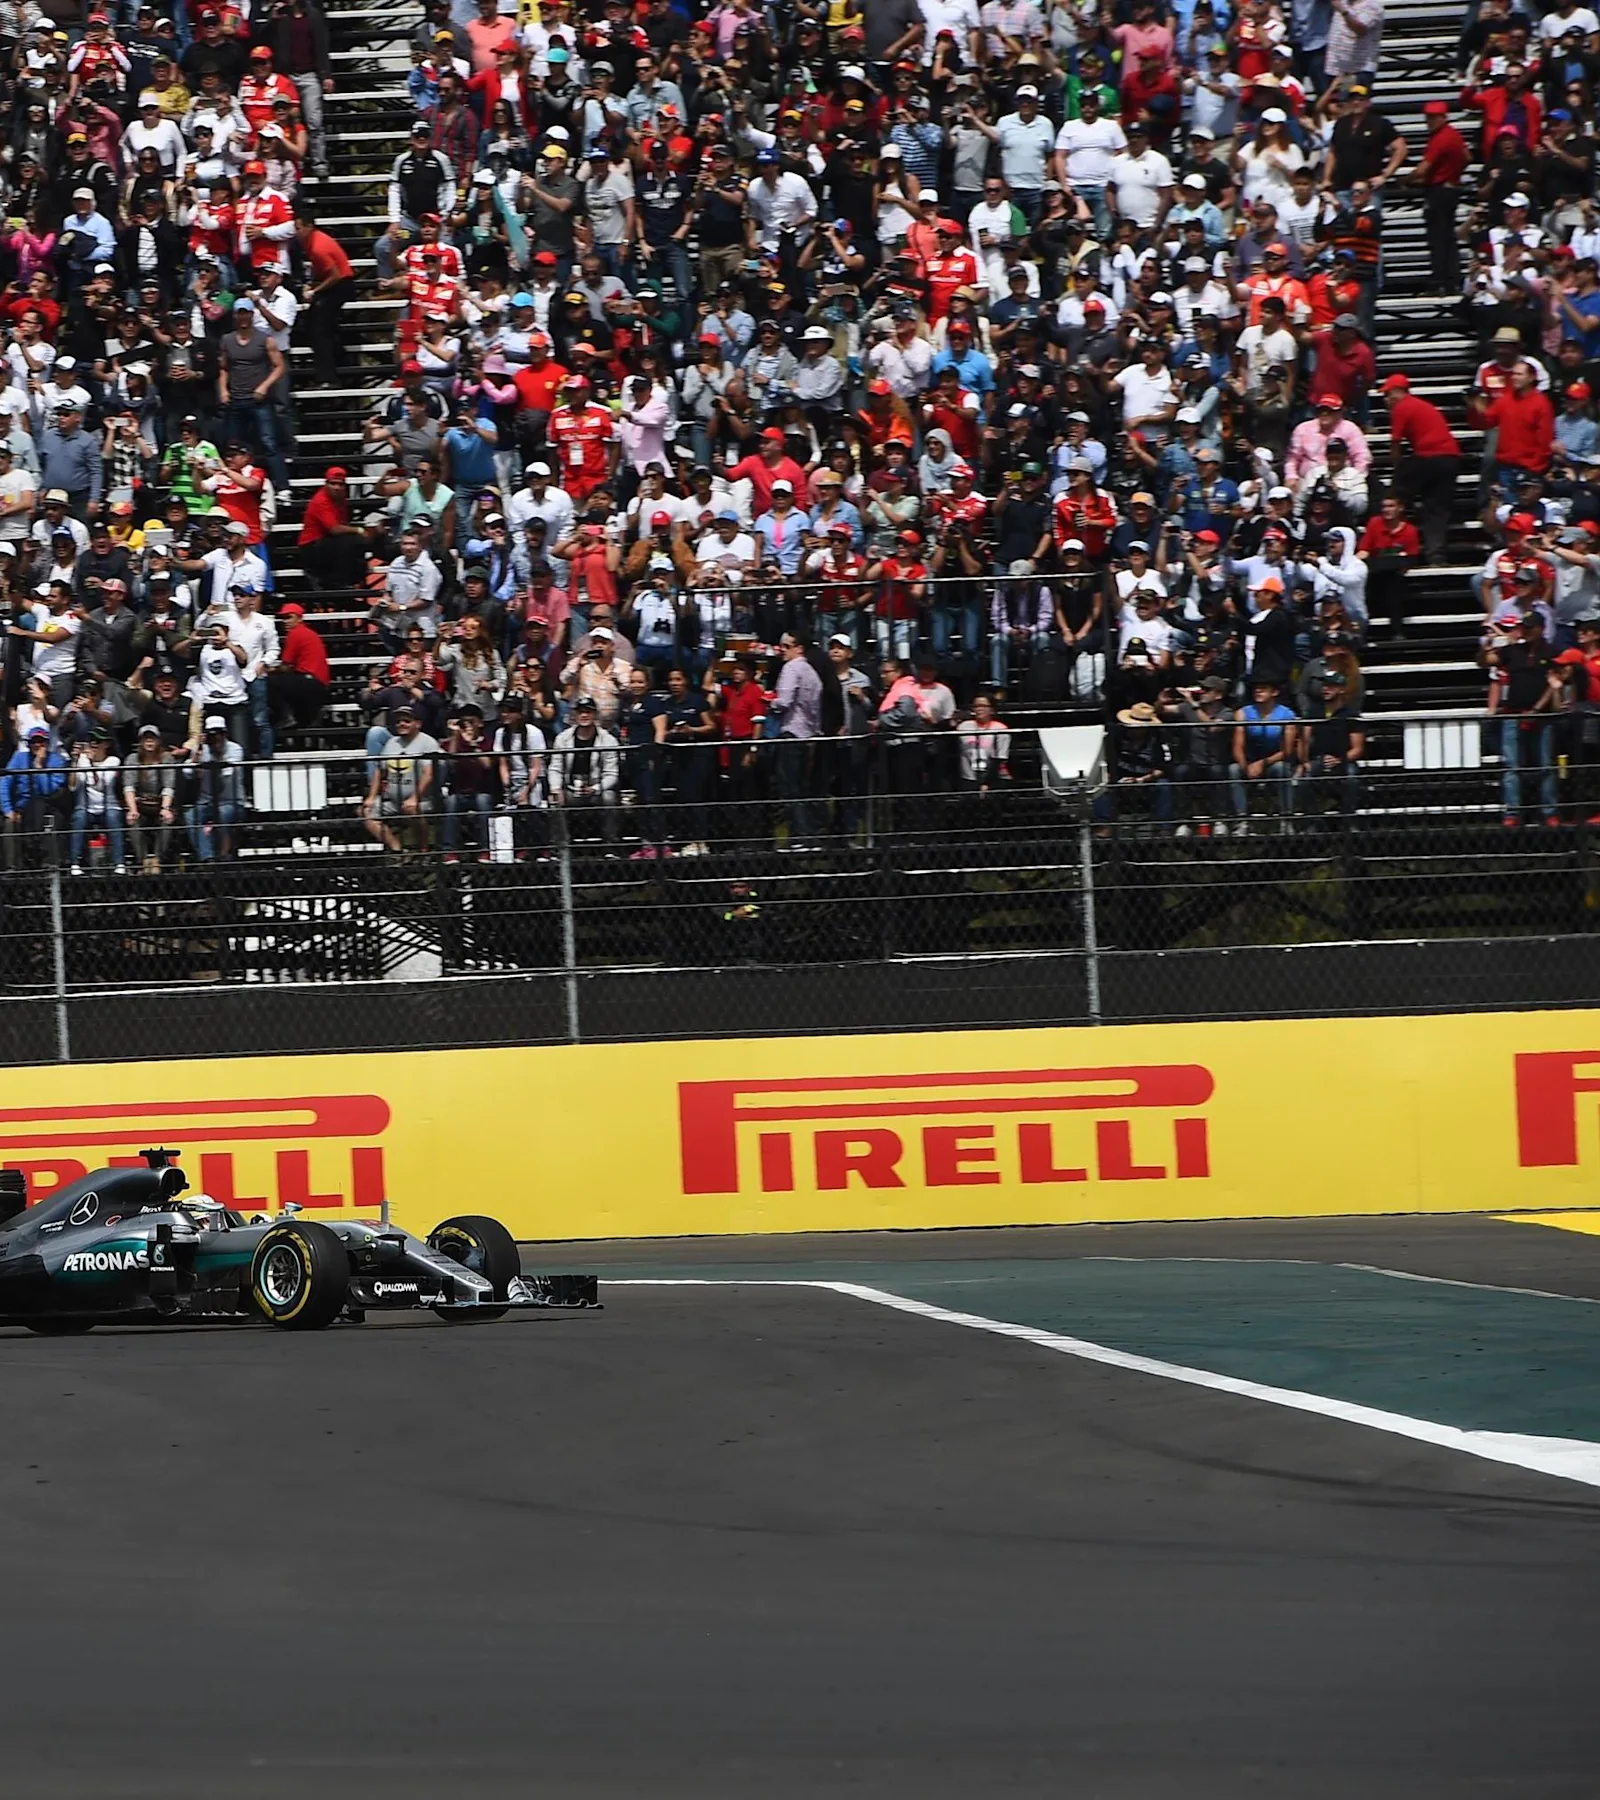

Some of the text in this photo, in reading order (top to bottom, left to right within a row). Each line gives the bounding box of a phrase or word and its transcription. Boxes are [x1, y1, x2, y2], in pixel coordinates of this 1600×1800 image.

[678, 1064, 1215, 1194] PIRELLI
[63, 1250, 150, 1271] PETRONAS
[374, 1281, 418, 1297] QUALCOMM
